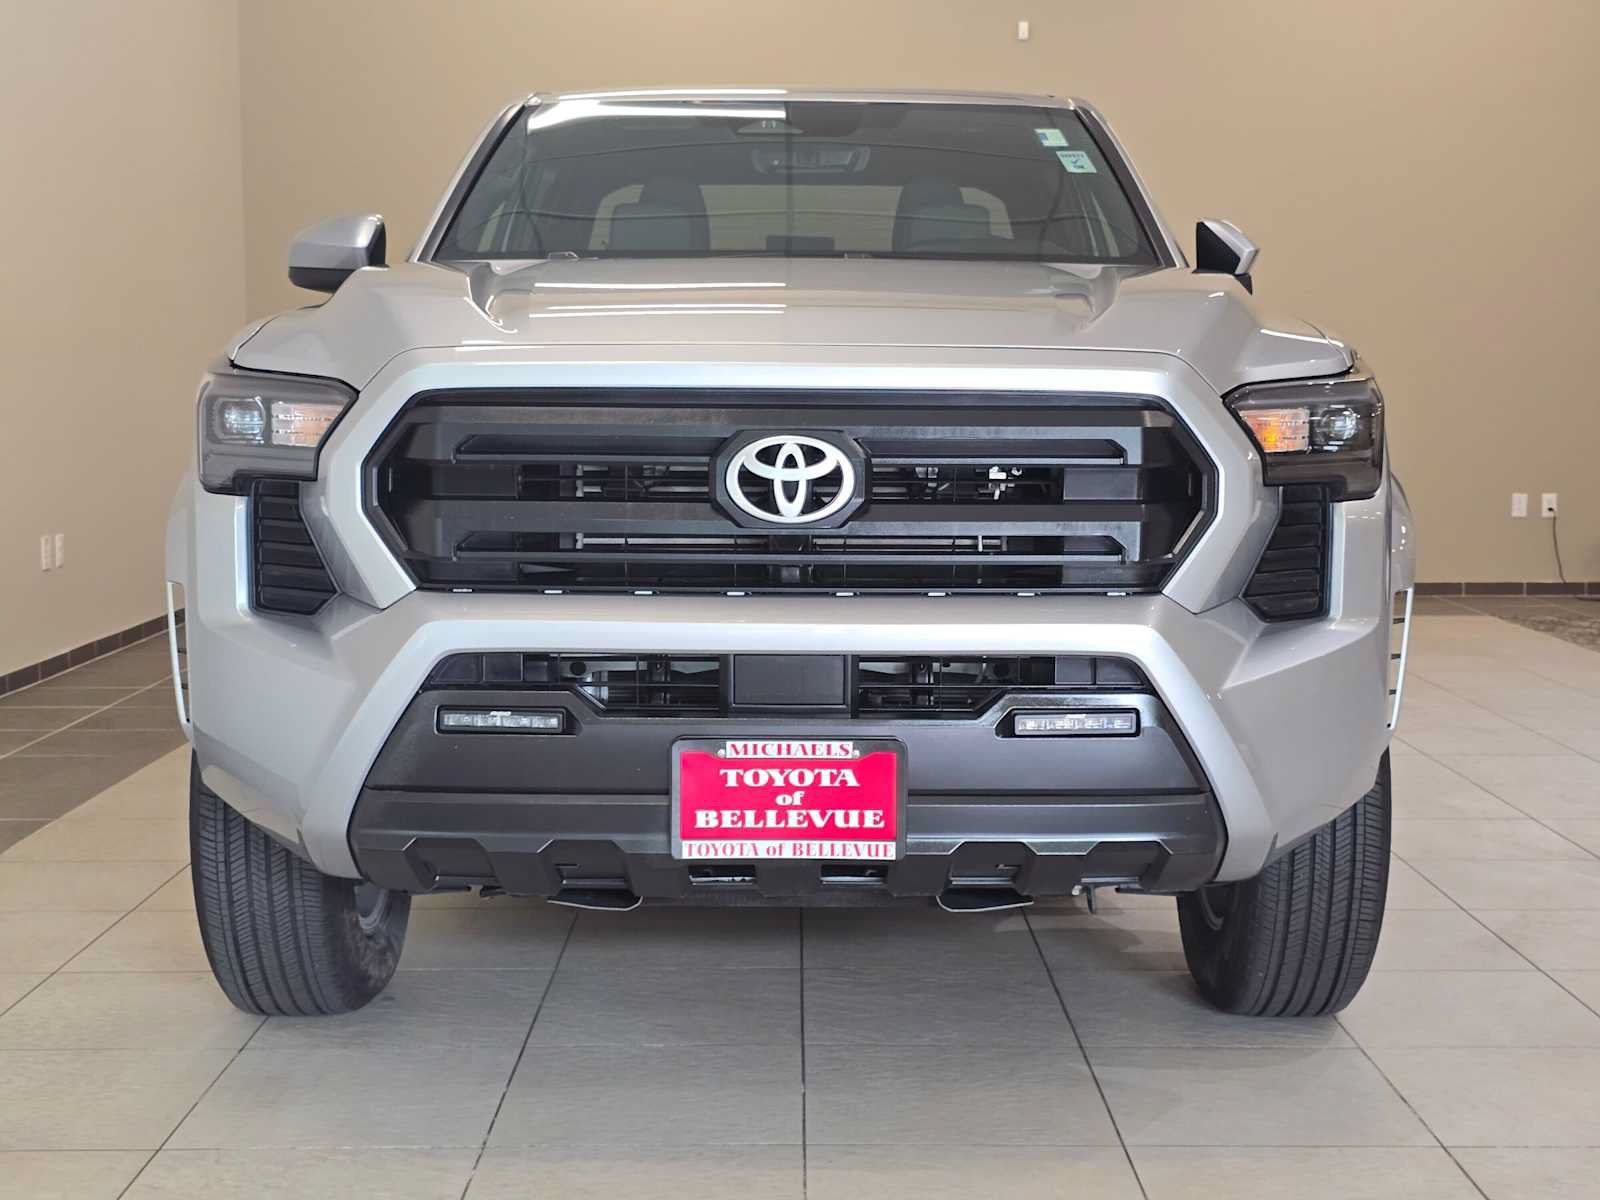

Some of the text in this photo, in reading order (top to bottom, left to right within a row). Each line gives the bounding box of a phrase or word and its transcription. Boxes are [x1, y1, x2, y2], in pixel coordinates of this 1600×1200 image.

[729, 743, 851, 757] MICHAELS
[719, 768, 861, 787] TOYOTA
[775, 791, 806, 806] of
[694, 809, 886, 829] BELLEVUE
[684, 842, 894, 858] TOYOTA of BELLEVUE
